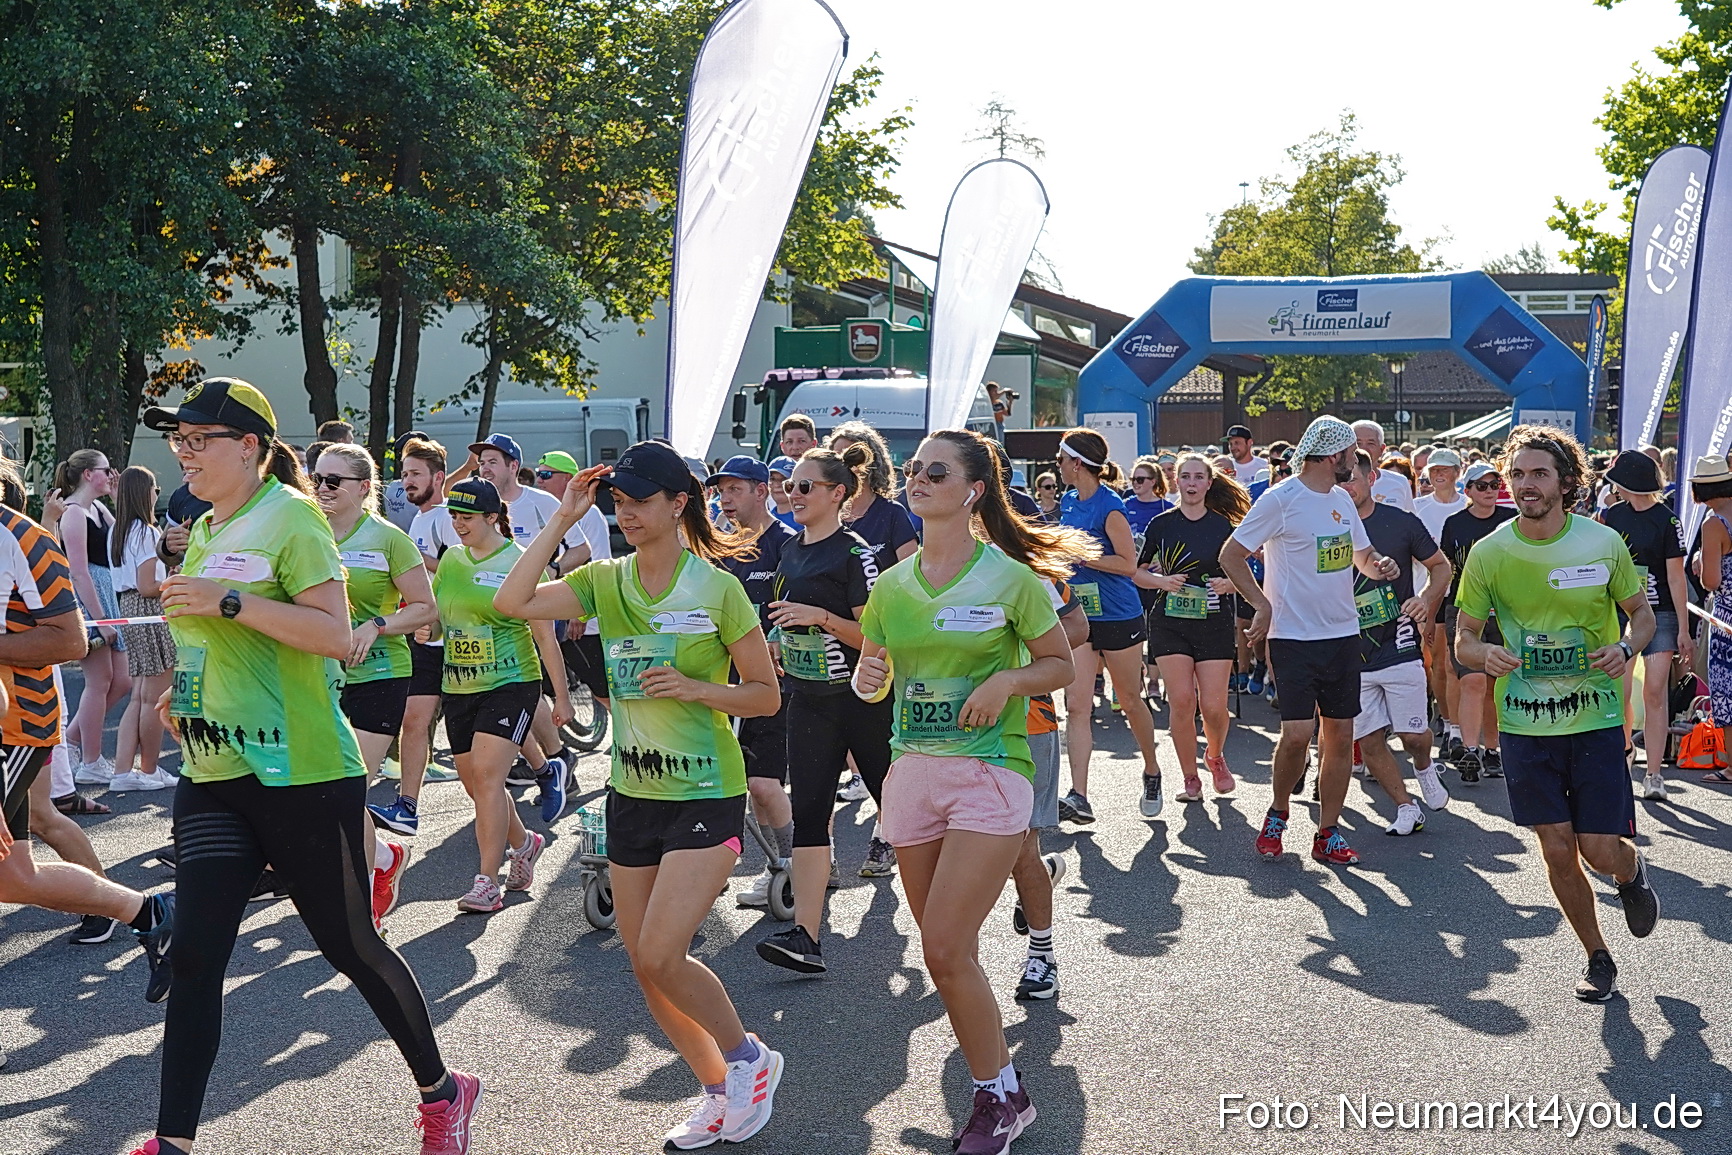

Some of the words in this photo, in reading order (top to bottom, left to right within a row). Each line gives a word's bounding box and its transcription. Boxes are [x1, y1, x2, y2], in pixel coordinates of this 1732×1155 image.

[1658, 172, 1701, 275] Fischer
[1303, 311, 1392, 329] firmenlauf
[1131, 342, 1179, 353] Fischer
[1326, 544, 1350, 561] 1977
[1176, 597, 1196, 608] 661
[454, 641, 481, 654] 826
[1531, 647, 1576, 664] 1507
[788, 648, 812, 666] 674
[818, 653, 826, 674] 2022
[1577, 647, 1586, 671] 2022
[617, 657, 654, 679] 677
[912, 702, 953, 723] 923
